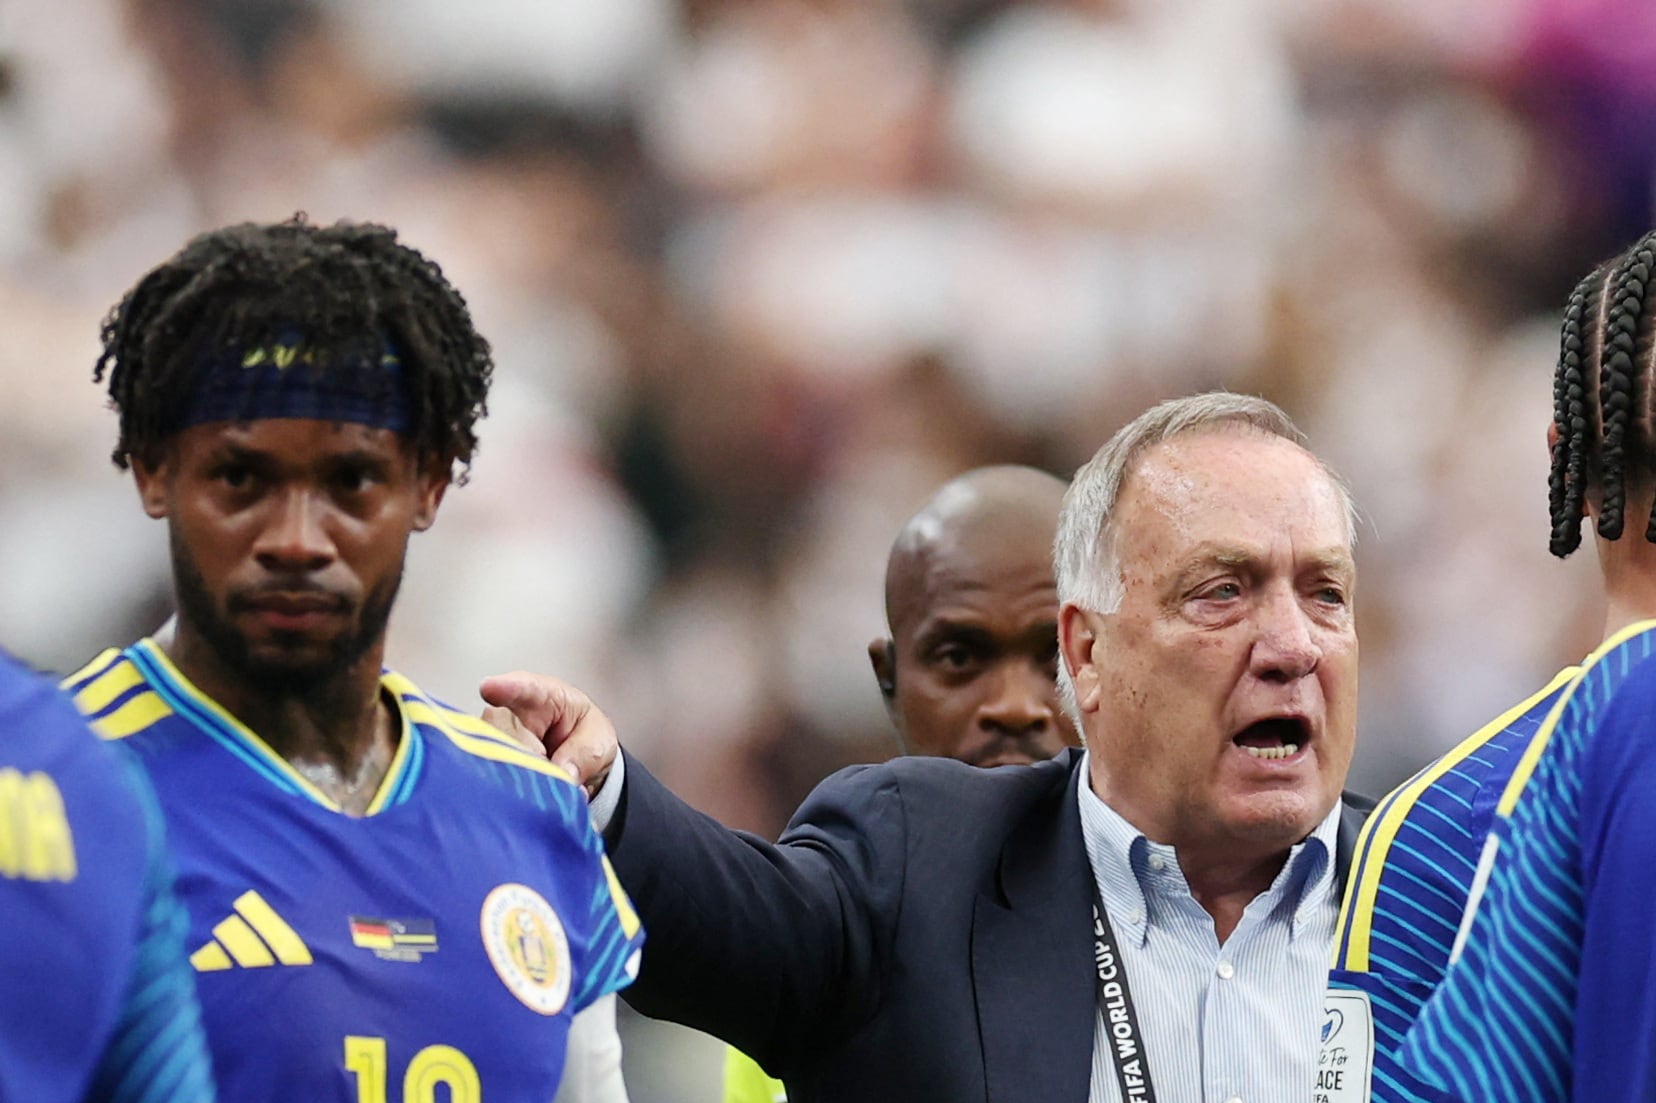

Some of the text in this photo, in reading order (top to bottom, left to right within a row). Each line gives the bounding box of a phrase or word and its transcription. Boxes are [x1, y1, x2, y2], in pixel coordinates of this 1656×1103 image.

[1096, 942, 1118, 980] CUP
[1103, 981, 1138, 1061] WORLD
[1314, 1069, 1344, 1091] ACE
